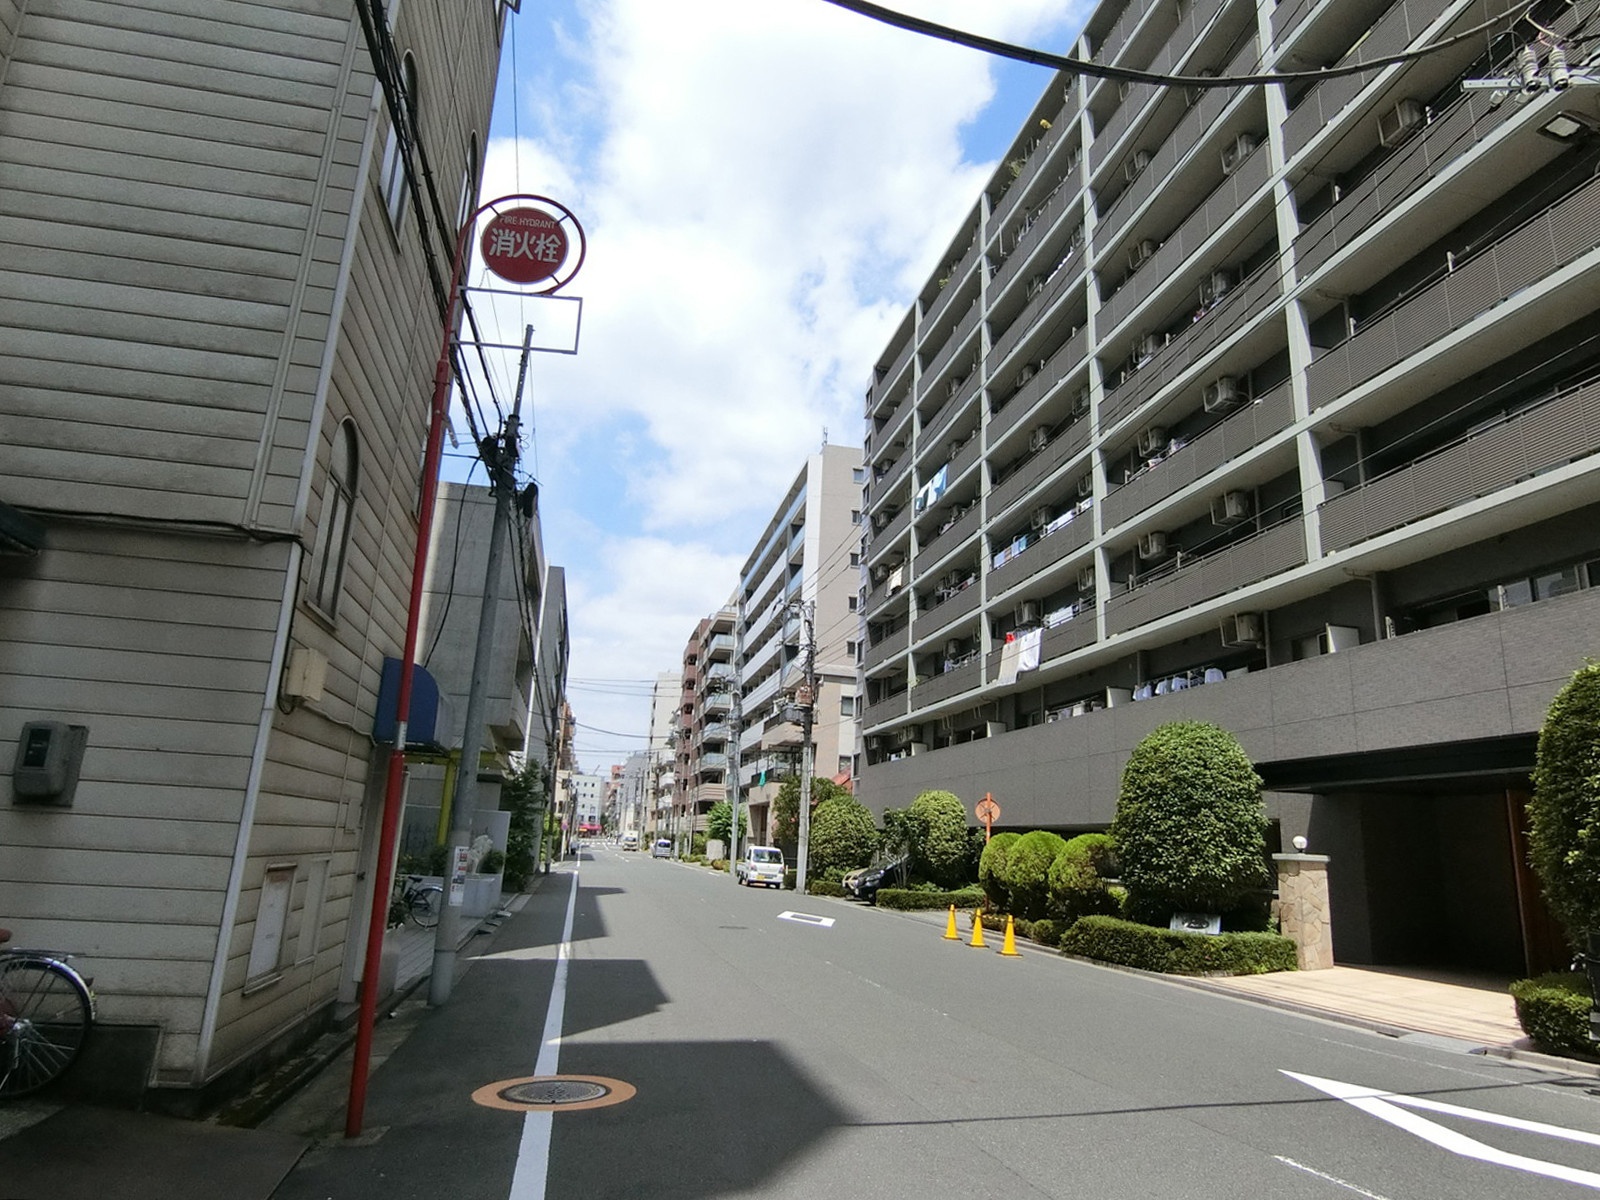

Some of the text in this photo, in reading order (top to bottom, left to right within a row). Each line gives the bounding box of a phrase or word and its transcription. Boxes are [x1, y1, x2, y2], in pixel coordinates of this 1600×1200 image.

[499, 215, 555, 229] FIRE HYDRANT
[489, 227, 562, 263] 消火栓
